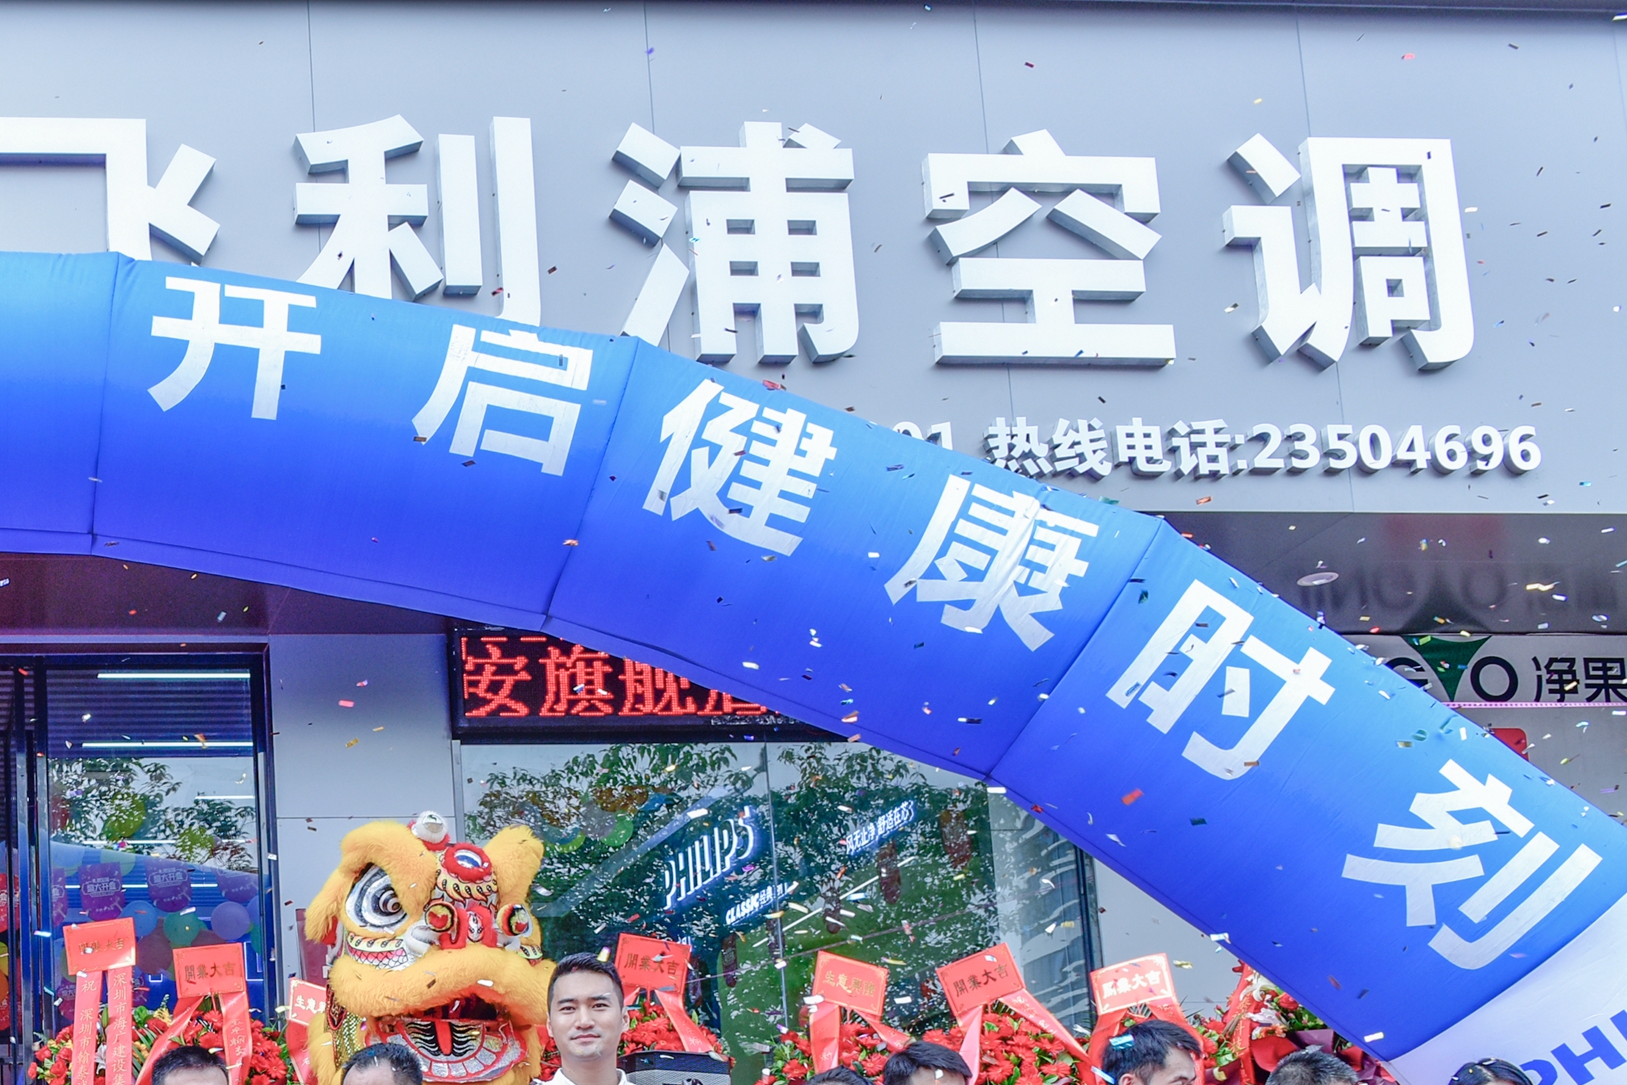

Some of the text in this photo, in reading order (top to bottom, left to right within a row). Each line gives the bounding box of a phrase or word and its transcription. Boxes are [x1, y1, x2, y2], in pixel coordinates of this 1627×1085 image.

[984, 416, 1542, 475] 热线电话:23504696
[147, 275, 1603, 970] 开启健康时刻
[184, 961, 236, 982] 開業大吉
[624, 953, 680, 976] 開業大吉
[81, 979, 97, 992] 祝
[824, 970, 877, 998] 生意興隆
[952, 963, 1009, 998] 開業大吉
[1101, 969, 1161, 1000] 開業大吉
